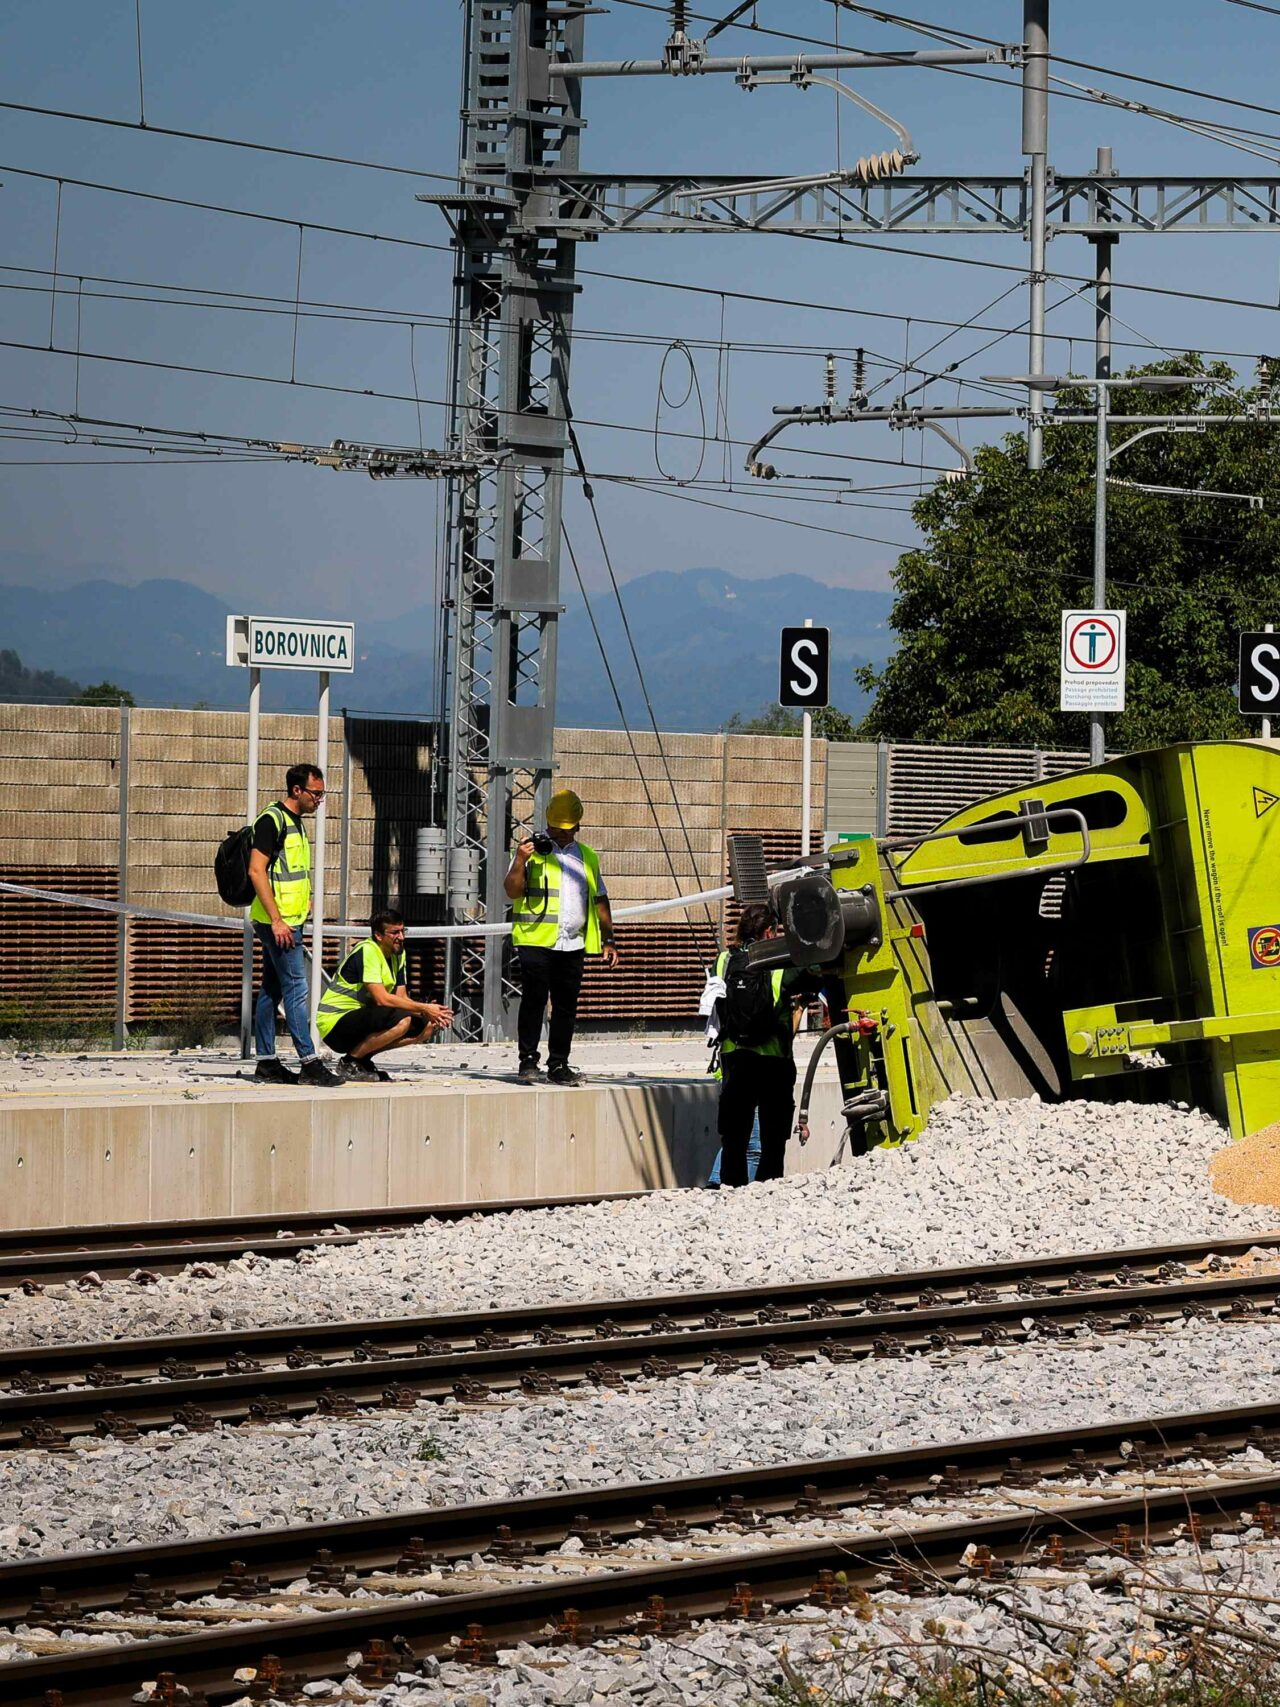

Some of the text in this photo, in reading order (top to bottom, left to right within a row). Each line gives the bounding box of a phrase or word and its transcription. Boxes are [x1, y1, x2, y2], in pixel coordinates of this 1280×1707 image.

[255, 630, 347, 659] BOROVNICA
[790, 639, 819, 696] S
[1250, 643, 1280, 701] S
[1203, 809, 1211, 828] Never
